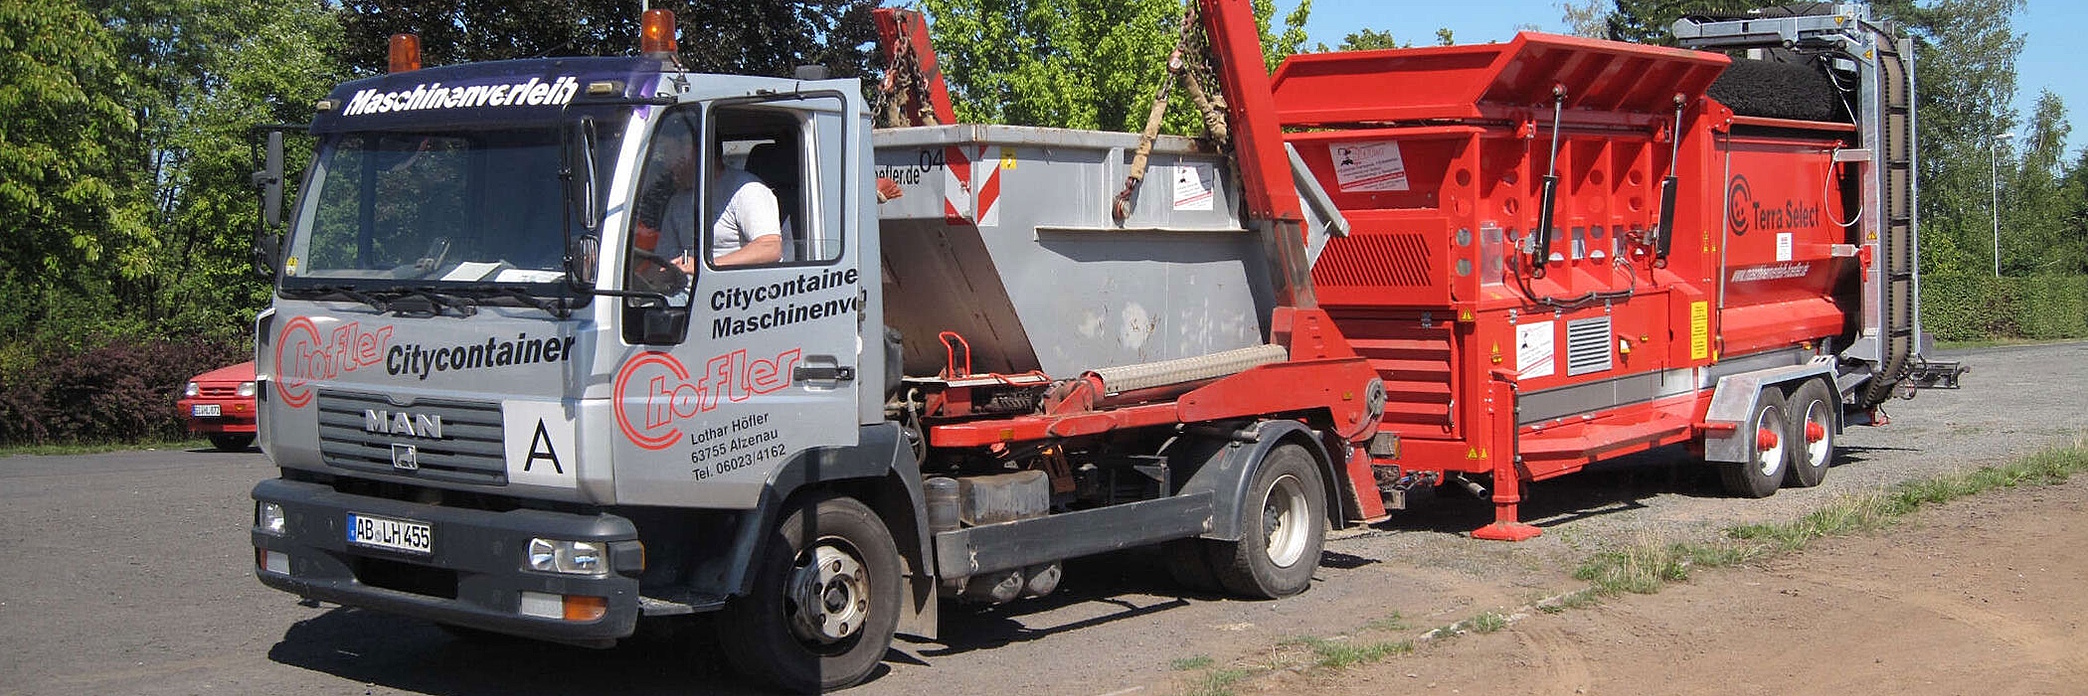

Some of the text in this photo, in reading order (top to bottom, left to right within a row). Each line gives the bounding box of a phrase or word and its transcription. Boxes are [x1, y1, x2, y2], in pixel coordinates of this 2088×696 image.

[343, 76, 579, 116] Maschinenverleih
[875, 164, 920, 185] efler.de
[920, 148, 945, 173] 04
[1752, 200, 1819, 230] Terra Select
[386, 333, 575, 380] Citycontainer
[365, 409, 442, 438] MAN
[691, 413, 769, 445] Lothar Höfler
[524, 417, 563, 474] A
[691, 429, 778, 464] 63755 Alzenau
[692, 443, 786, 481] Tel. 06023/4162
[357, 518, 374, 540] AB
[383, 522, 401, 545] LH
[404, 525, 430, 549] 455
